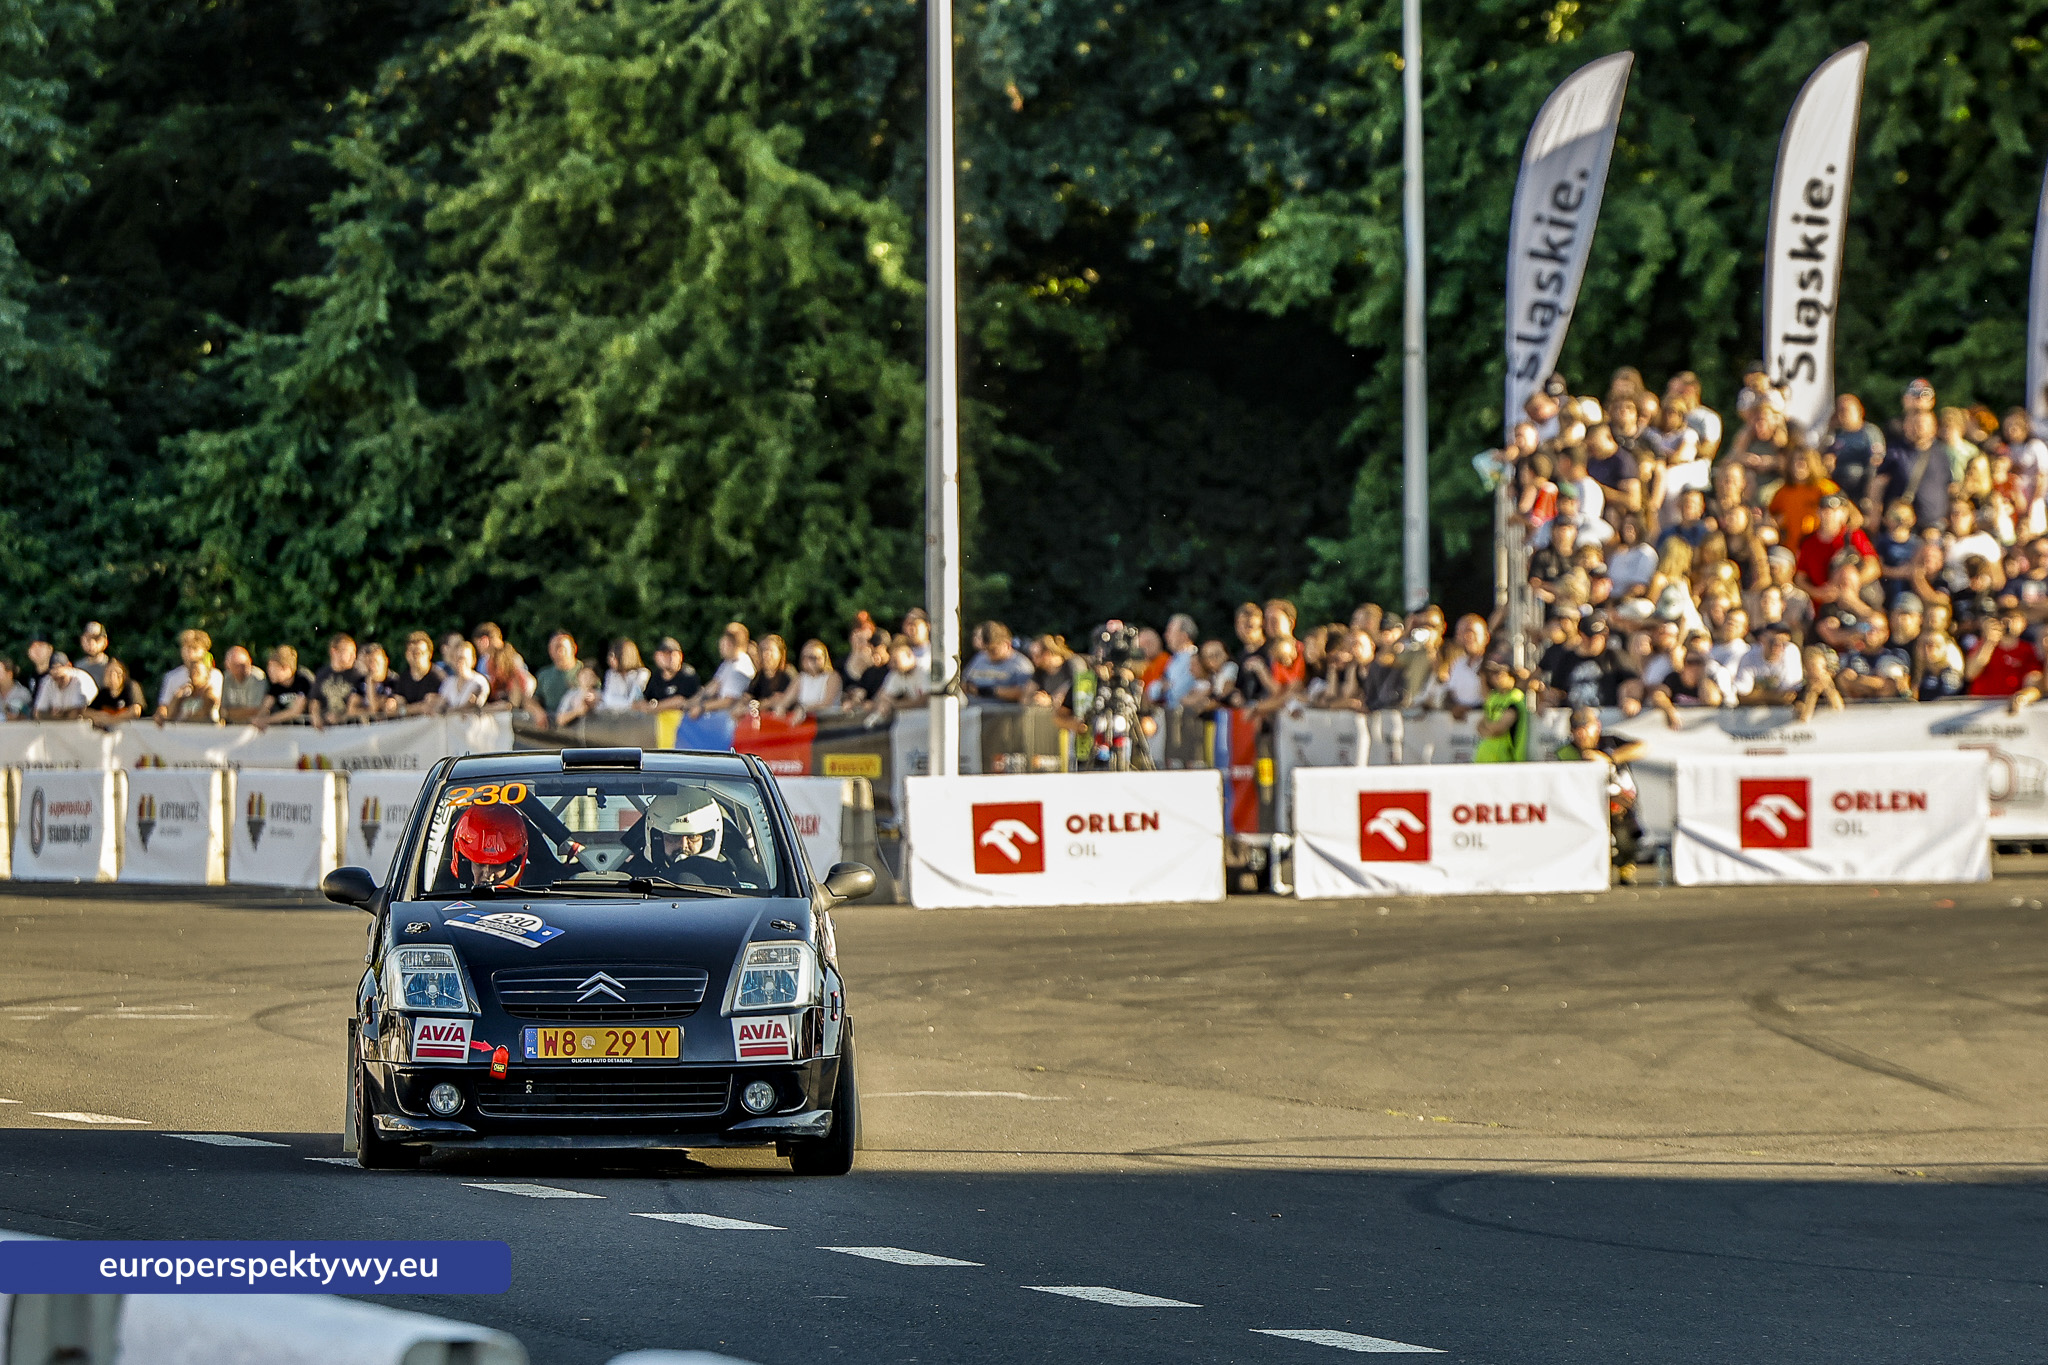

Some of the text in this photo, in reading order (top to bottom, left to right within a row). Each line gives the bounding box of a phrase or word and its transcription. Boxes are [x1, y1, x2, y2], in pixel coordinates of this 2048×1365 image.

[448, 783, 527, 807] 230
[1831, 790, 1927, 813] ORLEN
[1066, 812, 1160, 834] ORLEN
[1451, 803, 1547, 824] ORLEN
[1068, 843, 1097, 858] OIL
[1454, 832, 1484, 849] OIL
[492, 914, 537, 928] 230
[526, 1047, 537, 1055] PL
[543, 1030, 671, 1056] W8 291Y
